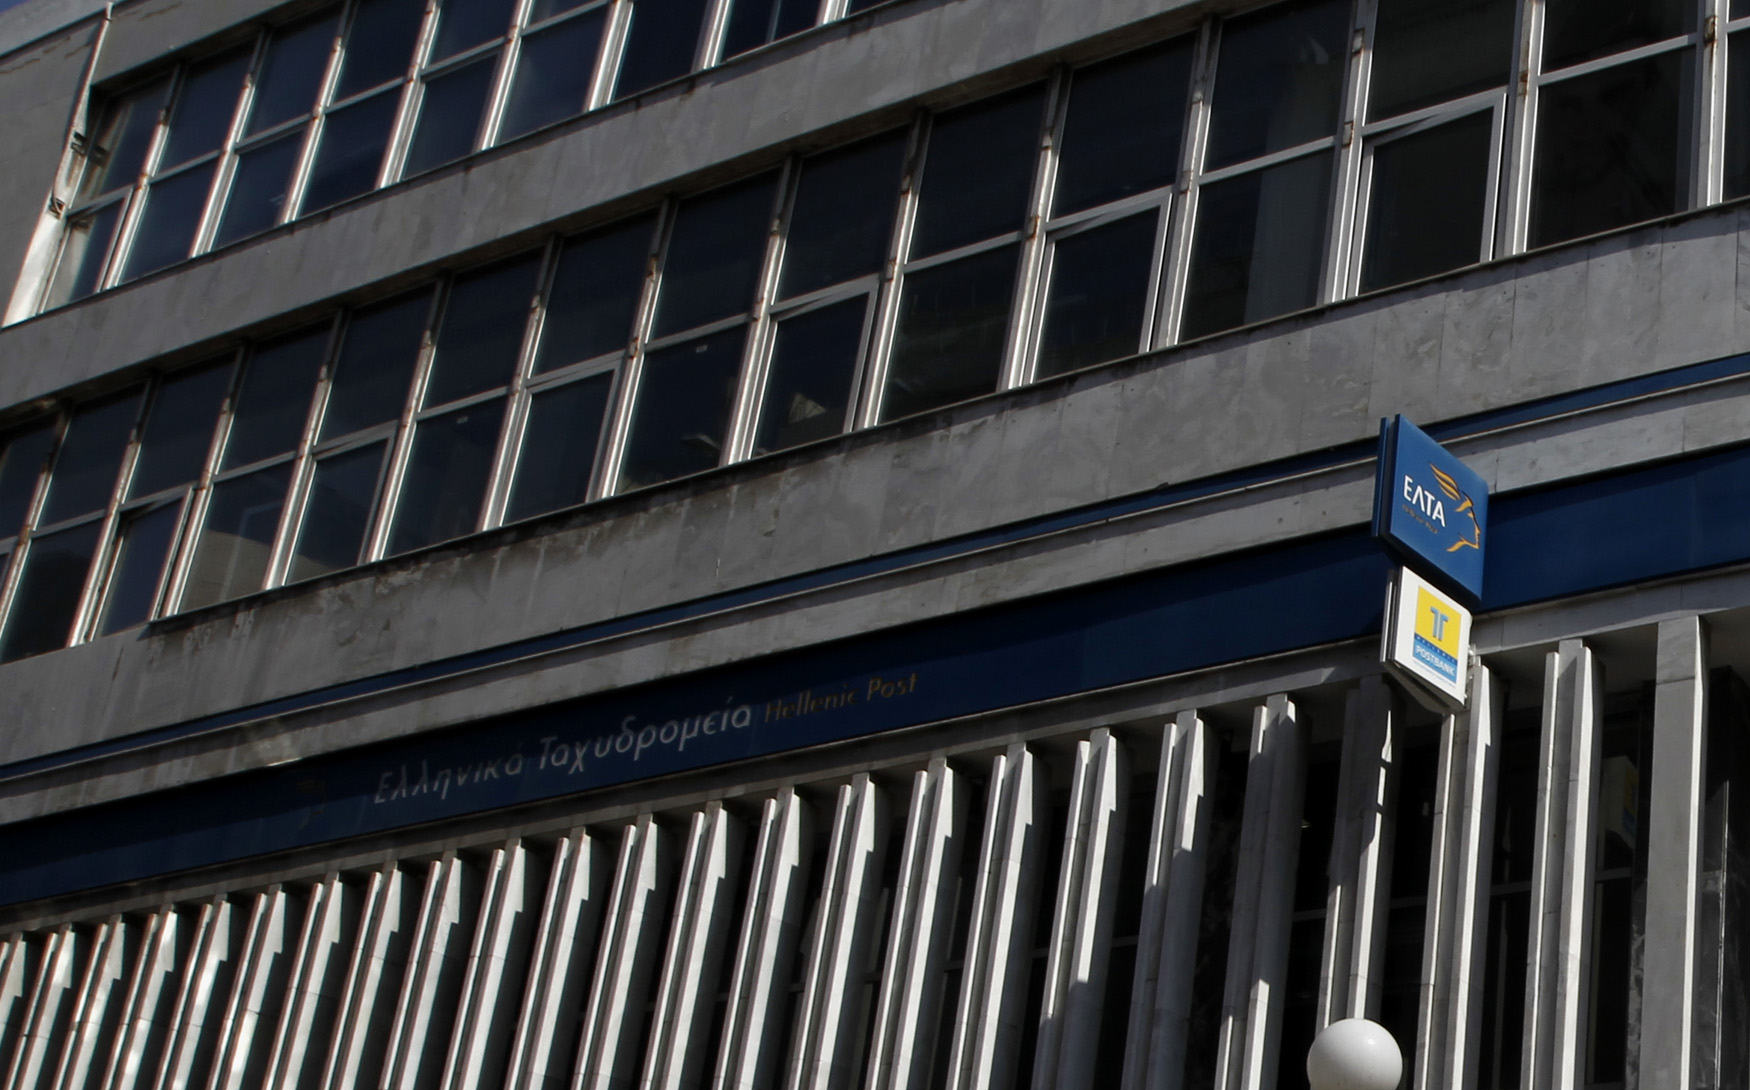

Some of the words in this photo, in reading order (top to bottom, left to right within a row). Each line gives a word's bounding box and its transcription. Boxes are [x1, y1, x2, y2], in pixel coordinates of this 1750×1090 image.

[1403, 474, 1446, 528] ΕΛΤΑ
[1415, 645, 1455, 678] POSTBANK
[765, 683, 860, 724] Hellenic
[866, 672, 918, 702] Post
[374, 739, 524, 804] Ελληνικά
[538, 697, 752, 775] Ταχυδρομεία
